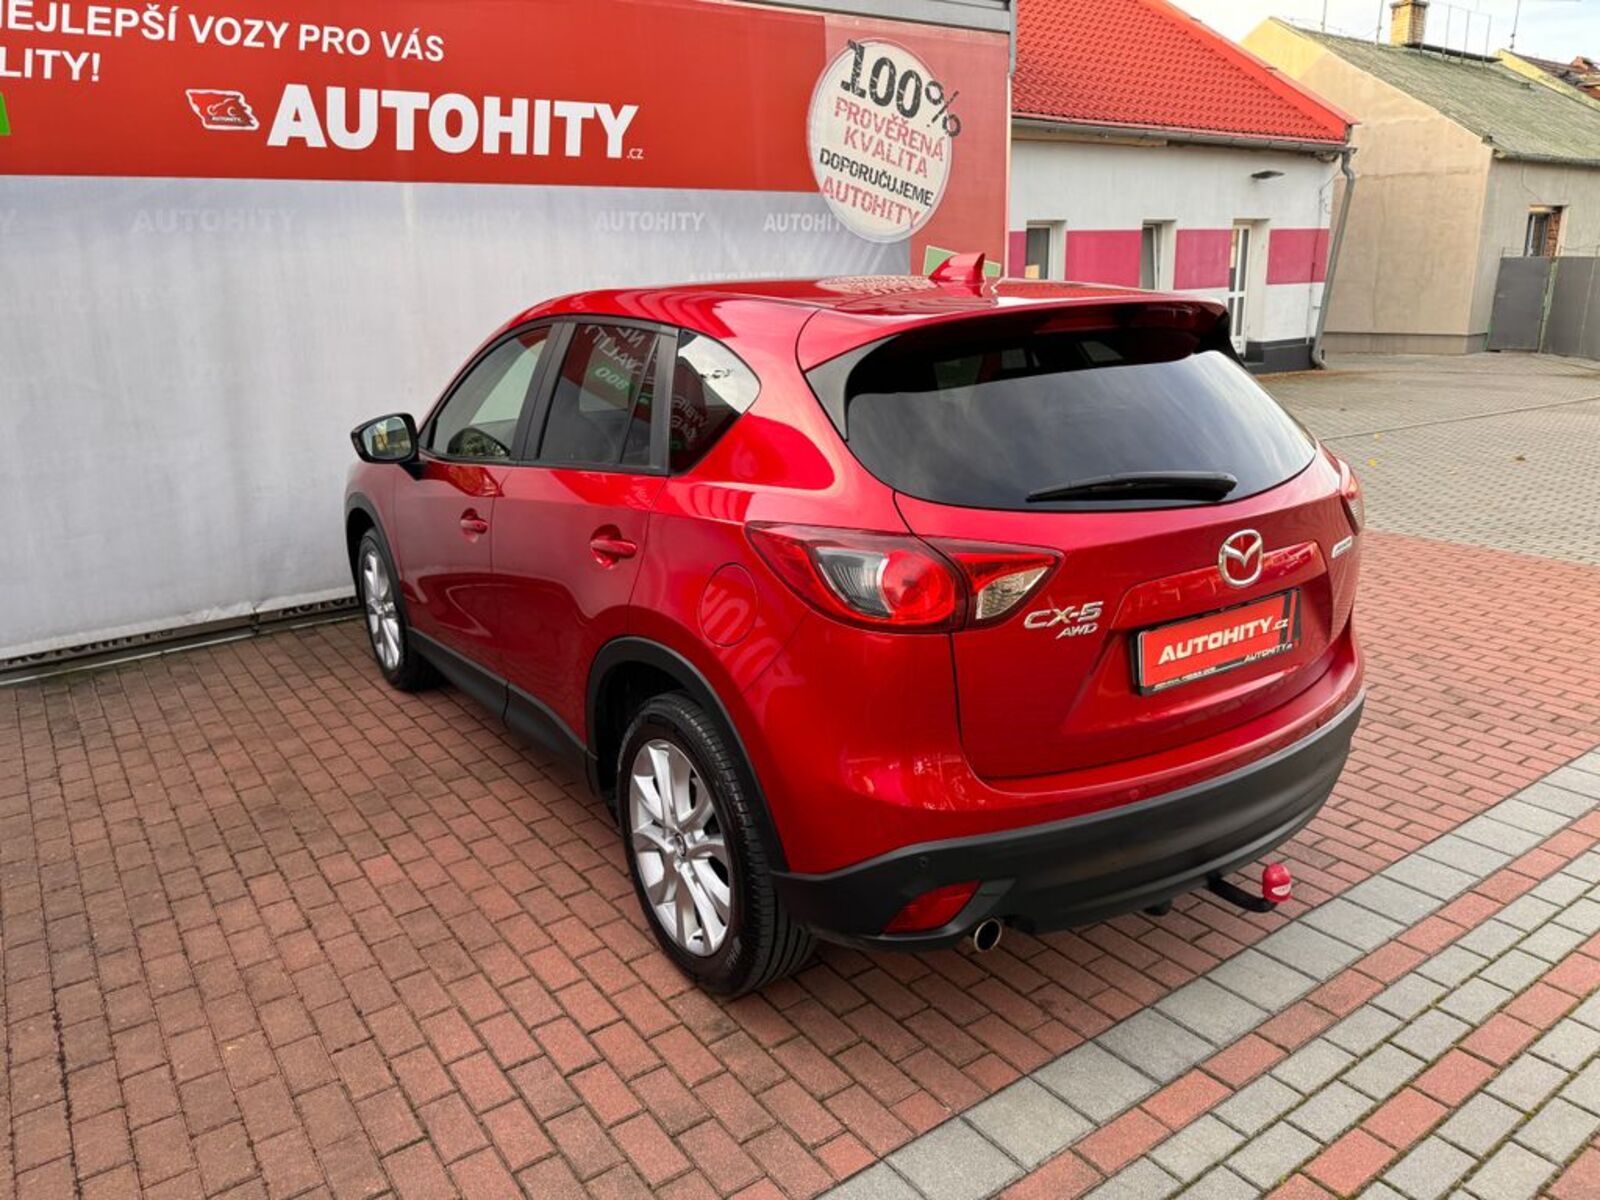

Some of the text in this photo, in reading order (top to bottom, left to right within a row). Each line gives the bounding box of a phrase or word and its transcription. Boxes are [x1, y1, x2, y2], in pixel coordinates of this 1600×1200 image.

[0, 0, 444, 62] EJLEPŠÍ VOZY PRO VÁS
[840, 38, 962, 138] 100%
[819, 147, 934, 208] DOPORUČUJEME
[844, 126, 928, 179] KVALITA
[595, 210, 706, 233] AUTOHITY
[821, 175, 921, 228] AUTOHITY
[1023, 600, 1104, 629] CX-5
[1055, 622, 1098, 640] AWD
